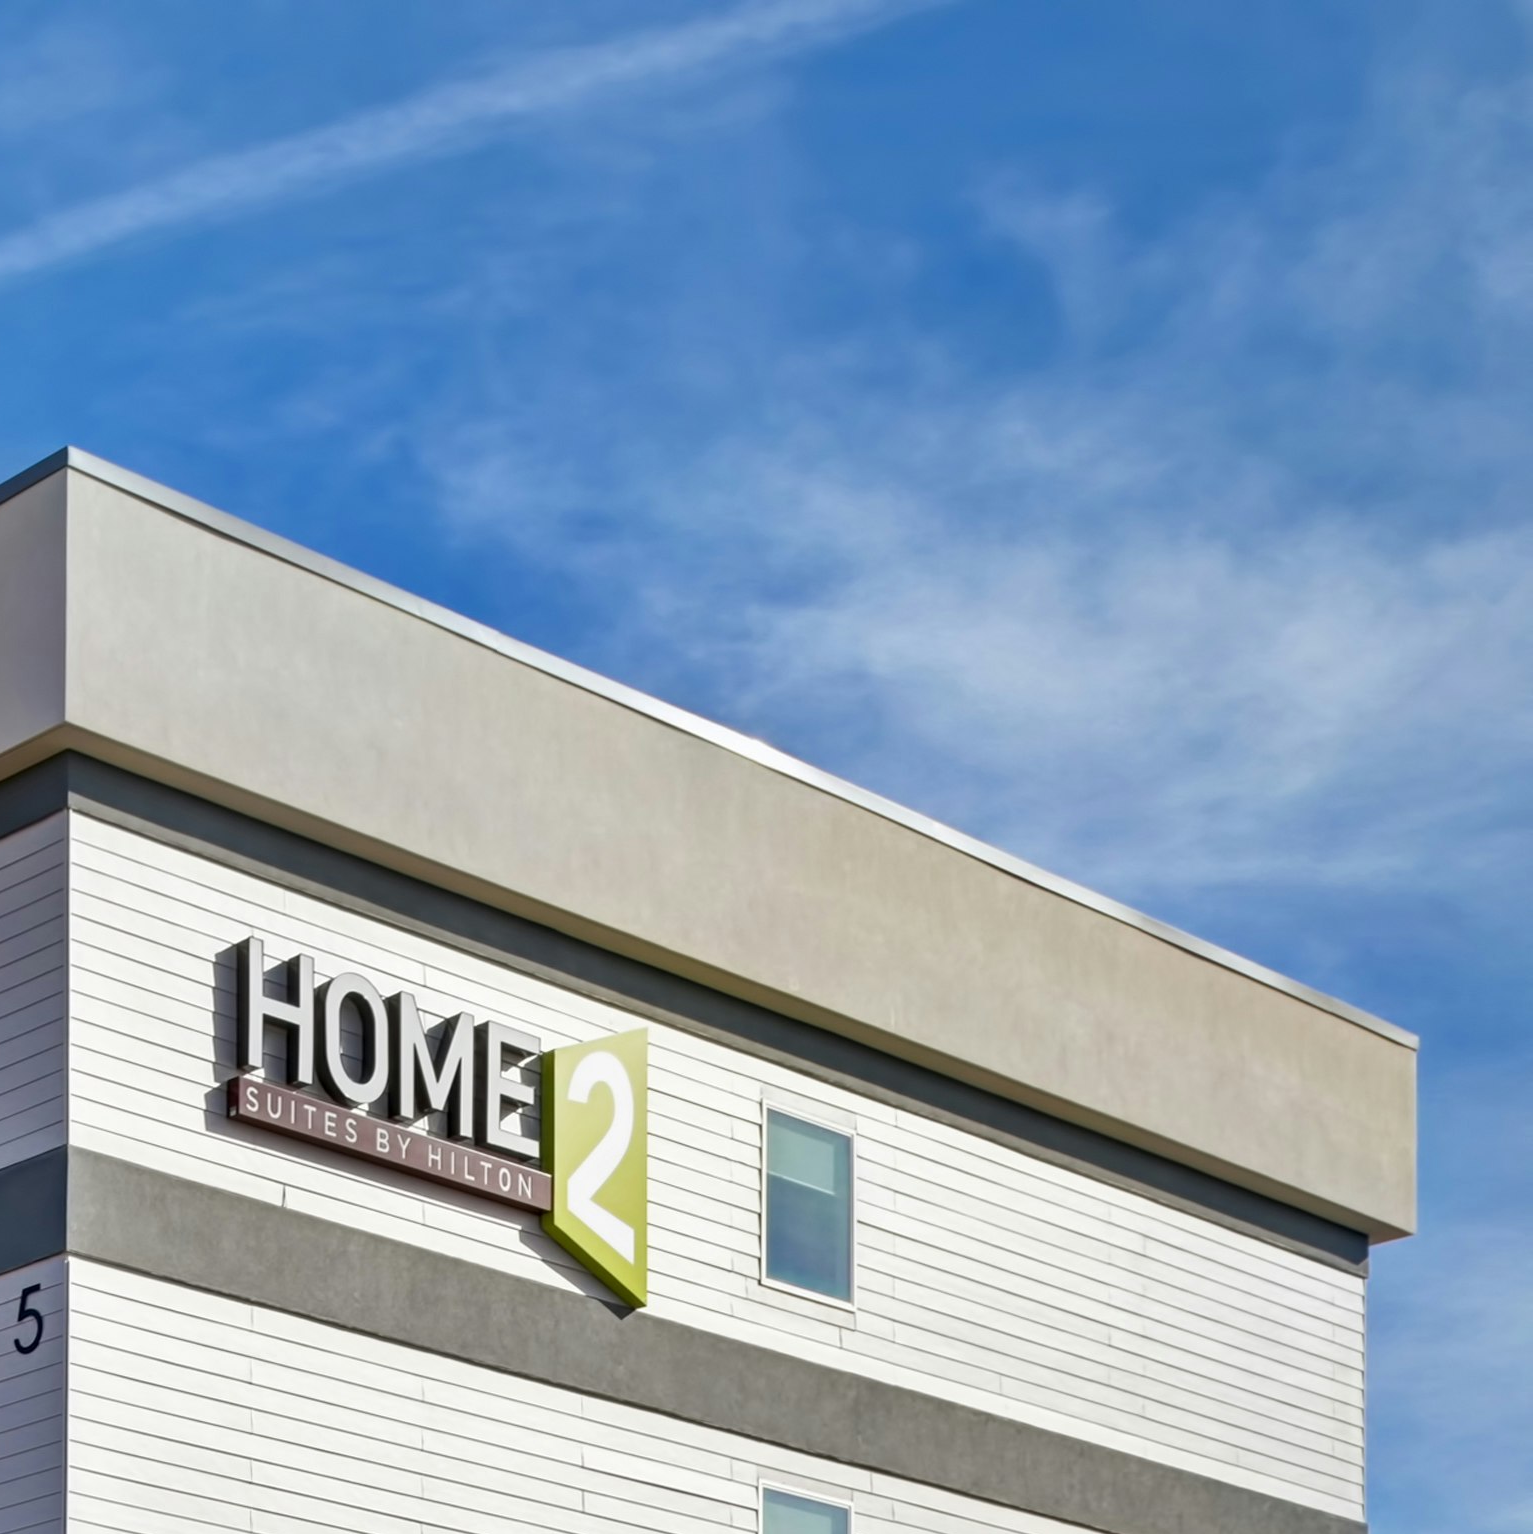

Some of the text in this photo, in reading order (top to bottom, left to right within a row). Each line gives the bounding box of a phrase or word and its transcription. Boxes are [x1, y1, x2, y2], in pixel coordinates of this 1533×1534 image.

[245, 1086, 533, 1200] SUITES BY HILTON
[246, 936, 635, 1266] HOME 2
